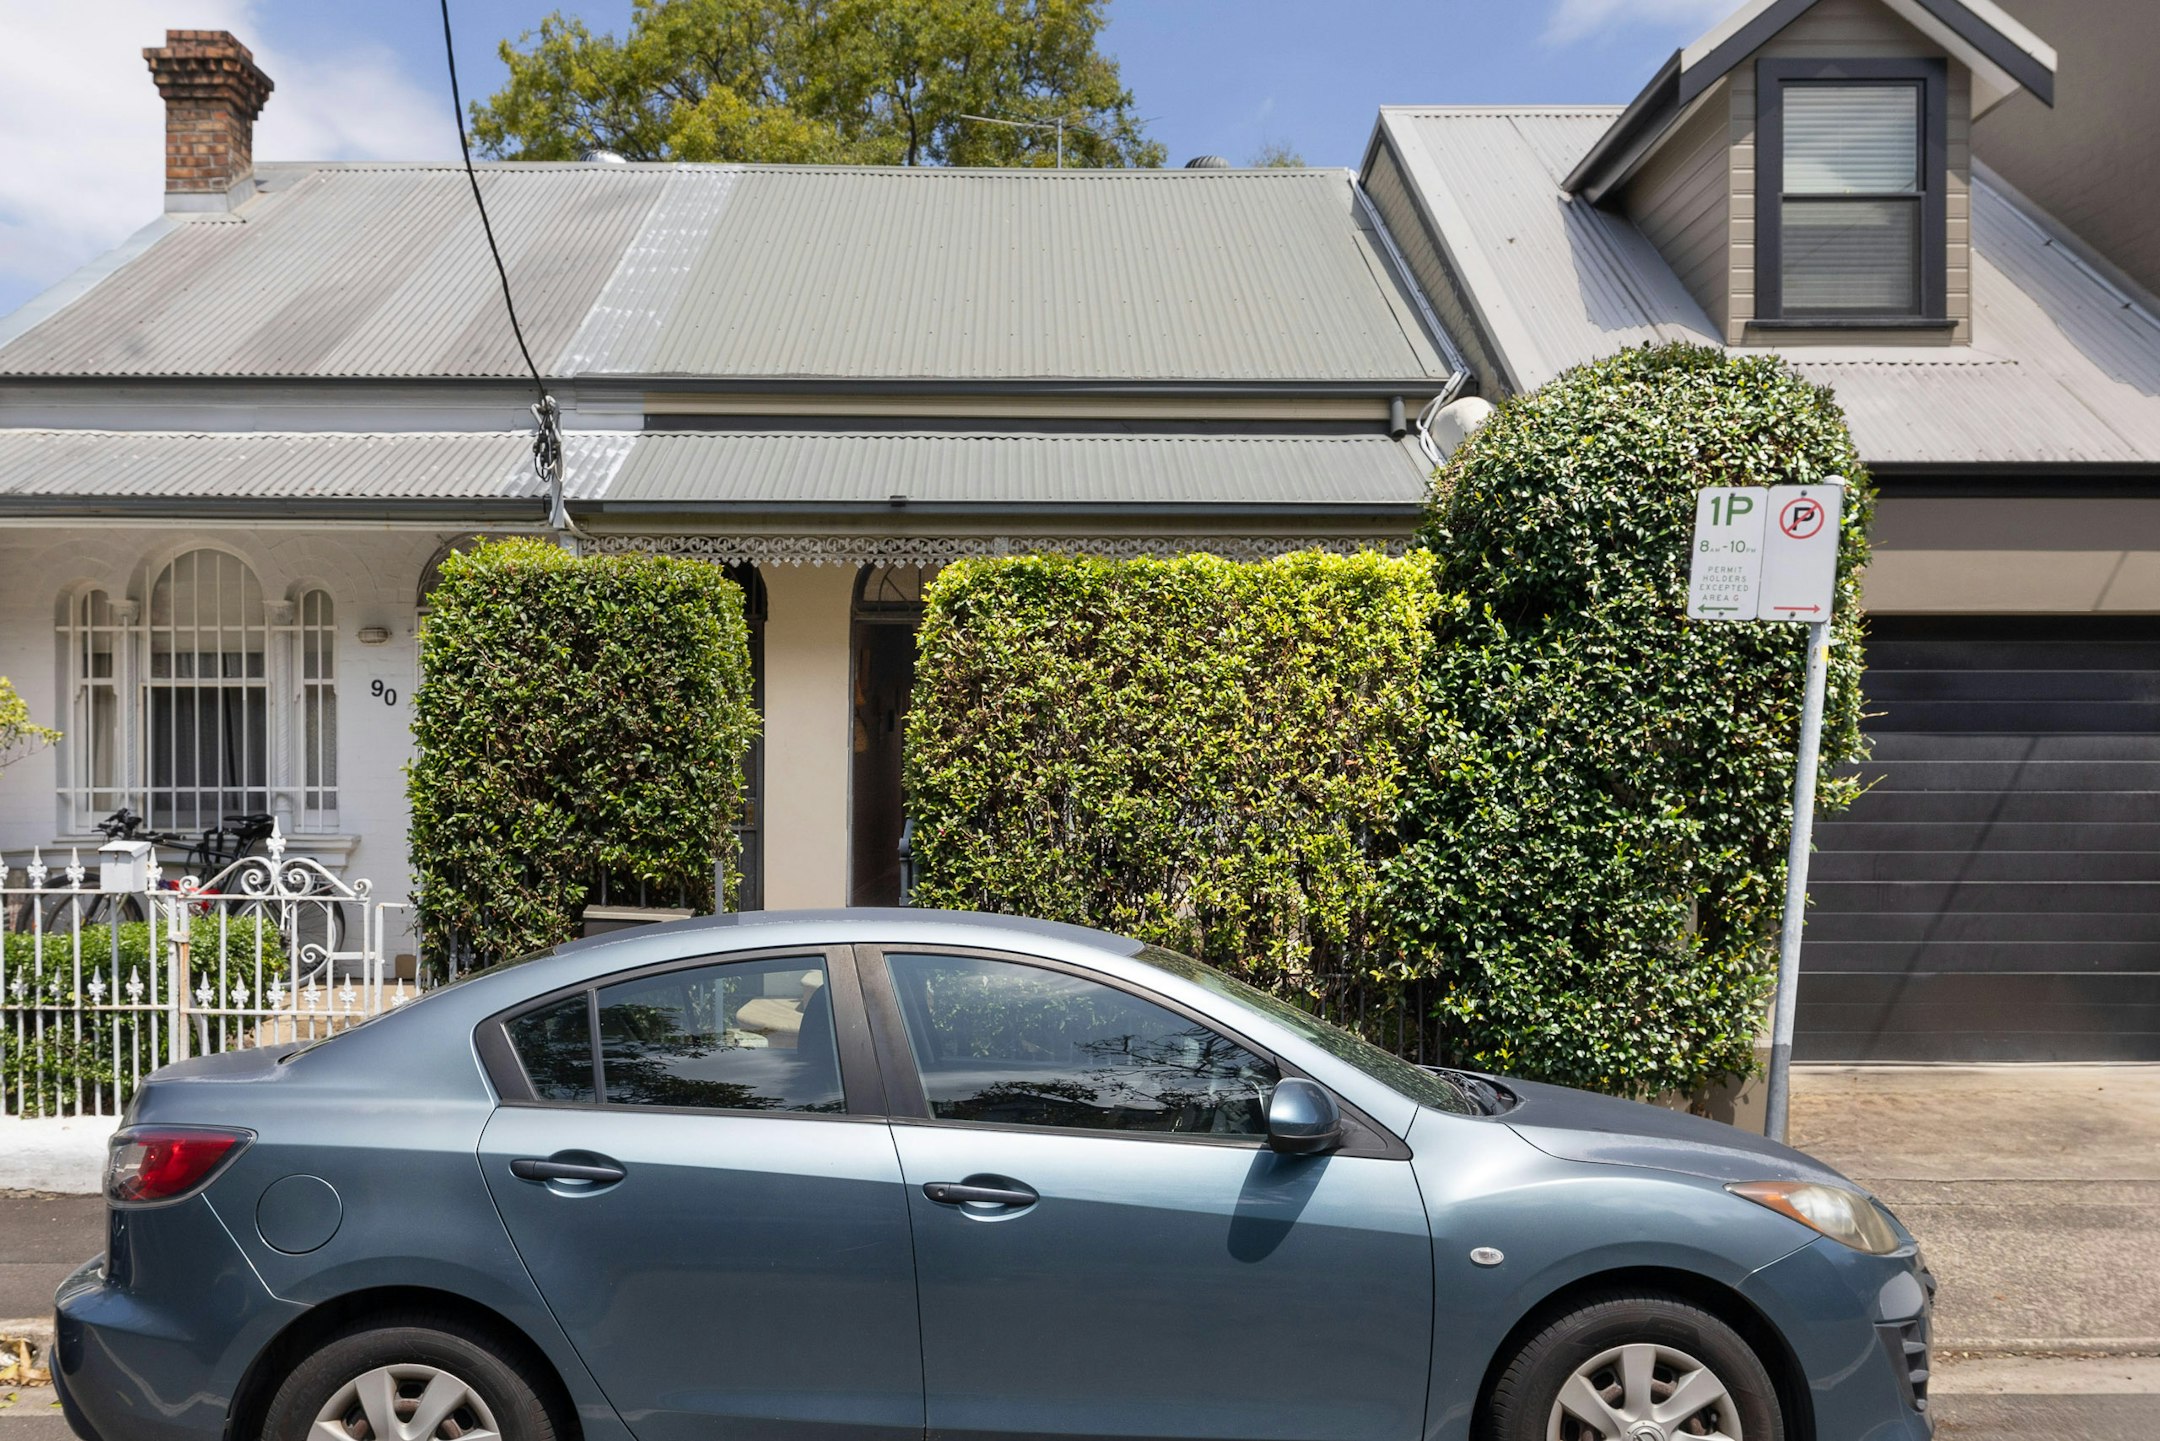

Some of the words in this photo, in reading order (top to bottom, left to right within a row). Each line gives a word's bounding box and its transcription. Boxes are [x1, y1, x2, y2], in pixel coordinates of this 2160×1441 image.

[1711, 496, 1754, 526] 1P
[1792, 506, 1815, 531] P
[1707, 566, 1743, 574] PERMIT
[1699, 584, 1749, 592] EXCEPTED
[1732, 594, 1739, 602] G
[371, 679, 397, 706] 90
